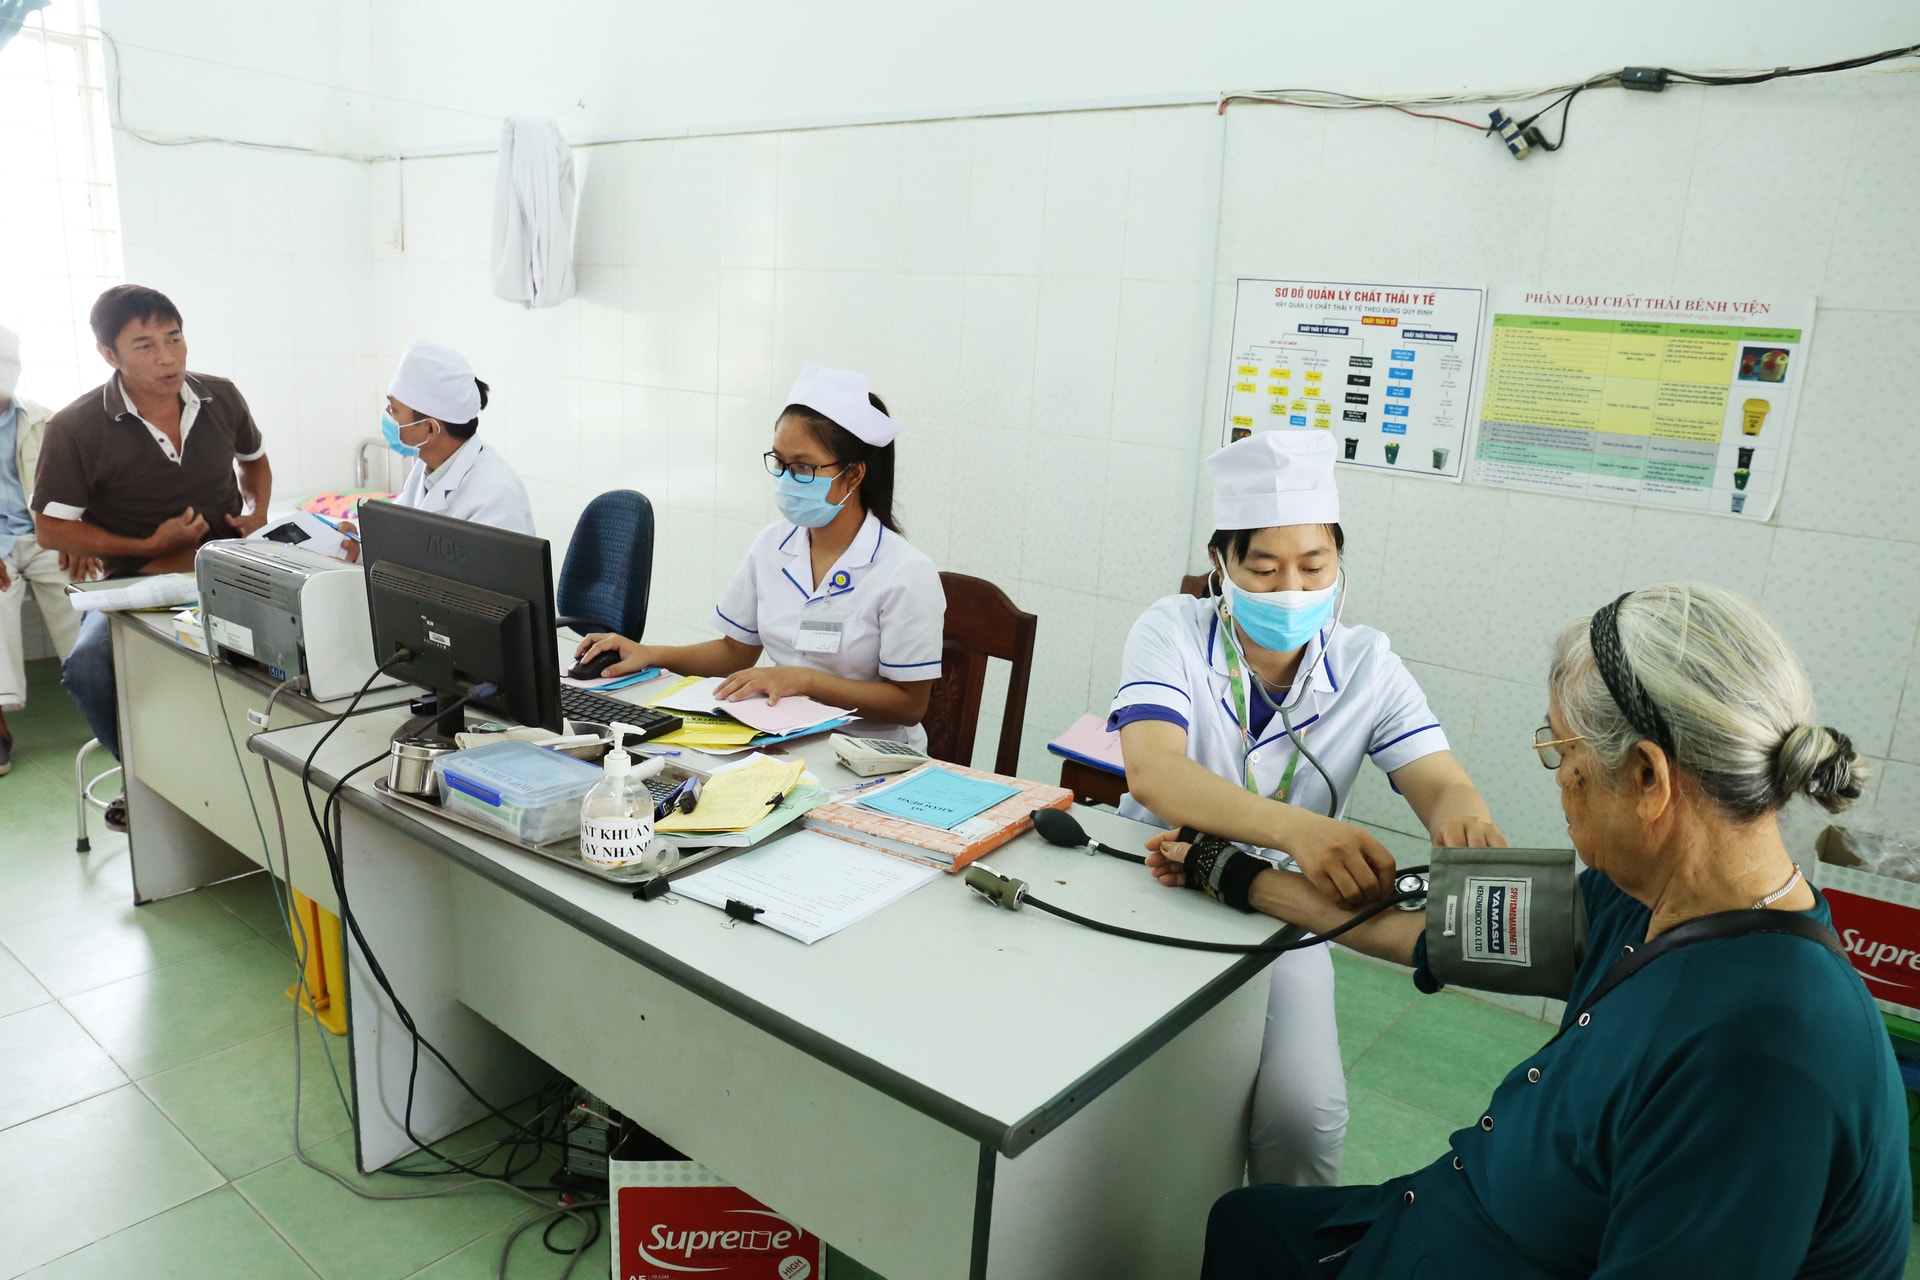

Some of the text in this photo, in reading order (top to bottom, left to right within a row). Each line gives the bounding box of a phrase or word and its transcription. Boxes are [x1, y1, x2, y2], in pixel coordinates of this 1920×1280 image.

[1307, 286, 1335, 300] QUẢN
[1354, 288, 1382, 303] CHẤT
[1385, 290, 1409, 304] THẢI
[1413, 294, 1419, 305] Y
[1423, 291, 1436, 306] TẾ
[1565, 294, 1599, 308] LOẠI
[1603, 293, 1642, 308] CHẤT
[1645, 296, 1680, 310] THẢI
[1733, 300, 1771, 316] VIỆN
[582, 820, 597, 838] ÁT
[1492, 890, 1501, 950] YAMASU
[1509, 887, 1518, 956] SPHYGMOMANOMETER
[1475, 938, 1483, 953] LTD.
[782, 1259, 803, 1276] HIGH
